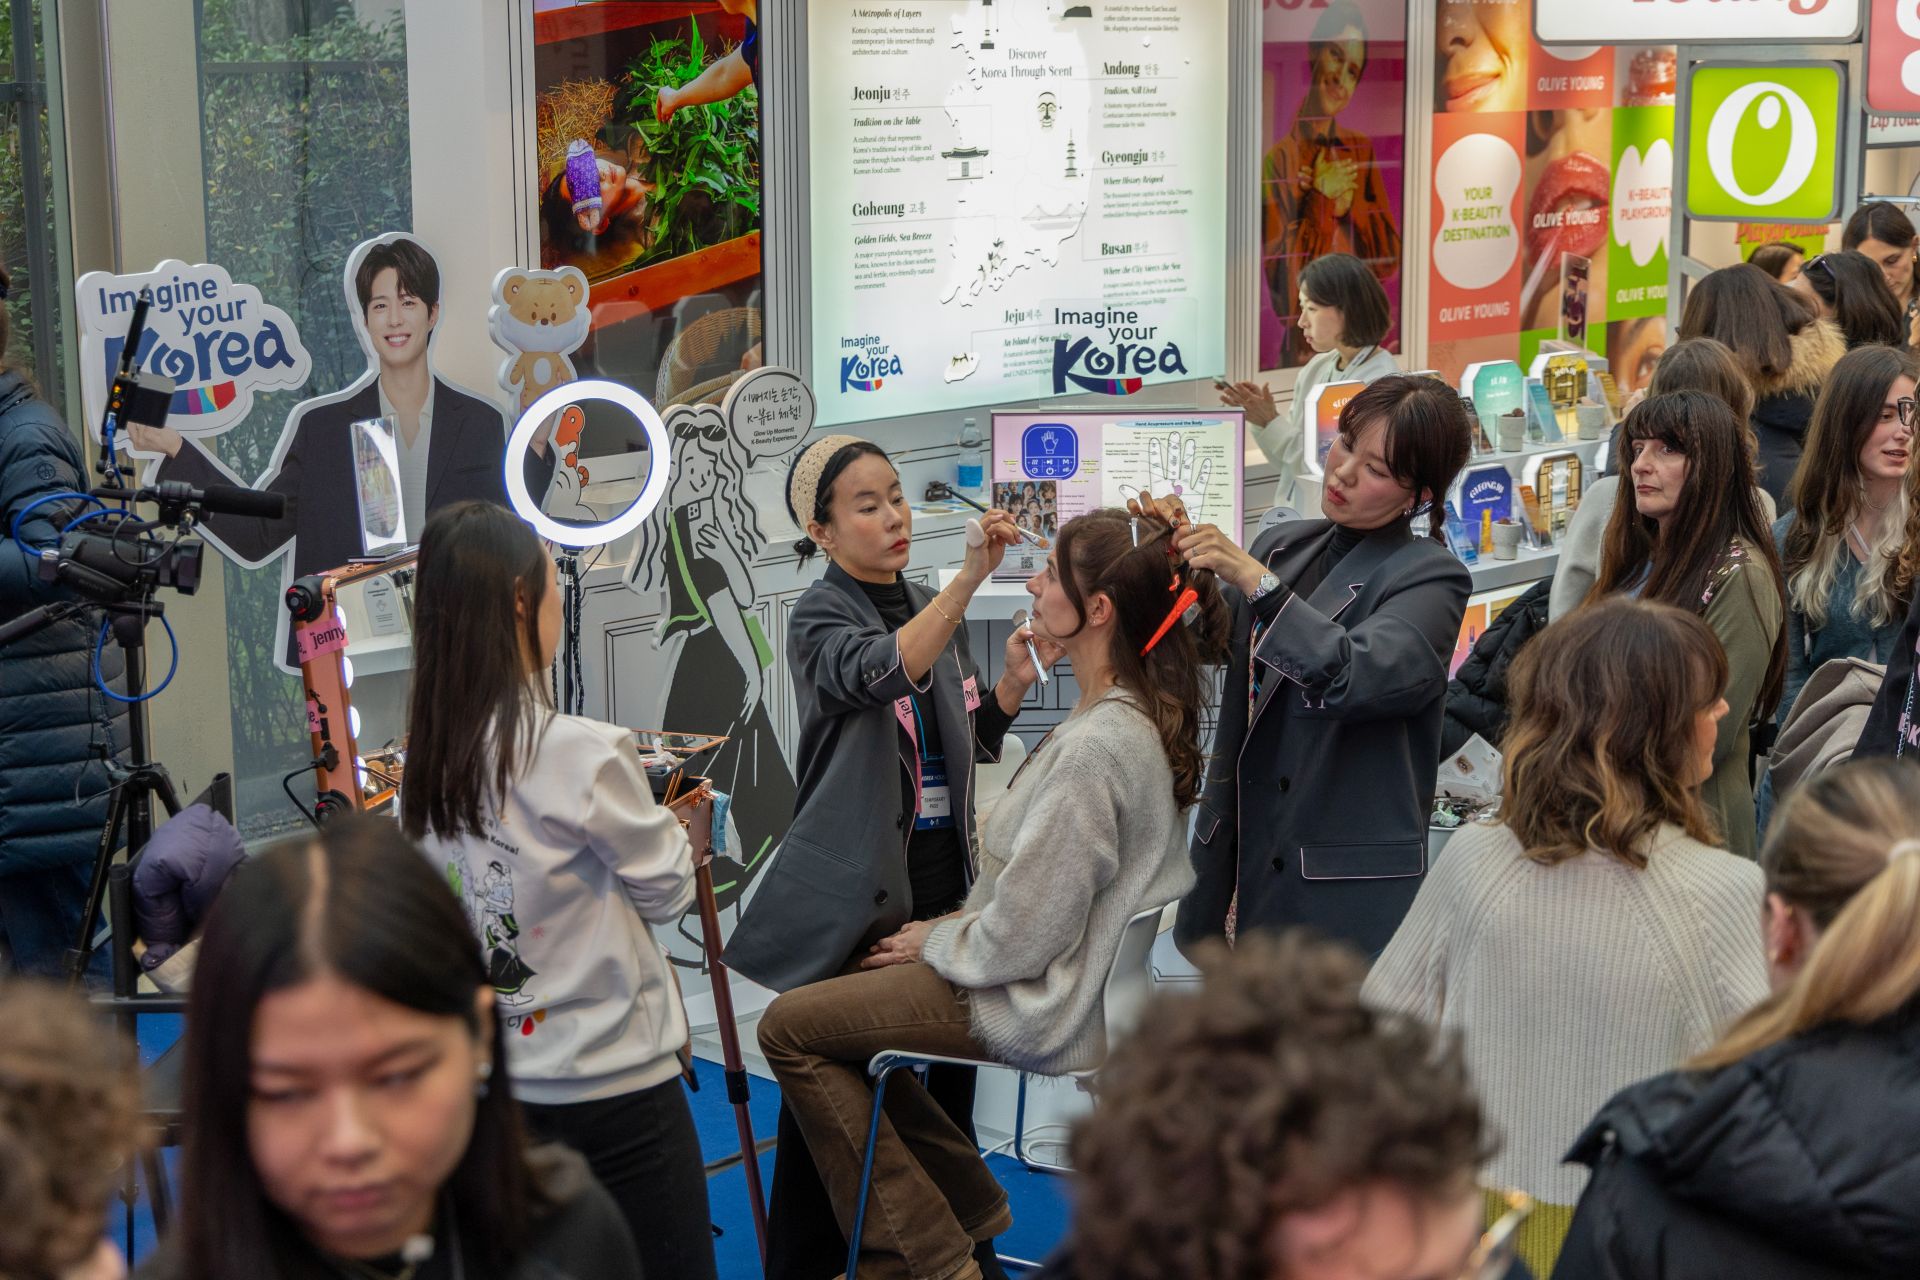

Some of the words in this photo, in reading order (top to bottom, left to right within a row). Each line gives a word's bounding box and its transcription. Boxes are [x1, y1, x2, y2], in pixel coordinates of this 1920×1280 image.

[851, 9, 857, 17] A
[859, 9, 892, 20] Metropolis
[894, 8, 902, 20] of
[902, 9, 922, 20] Layers
[1008, 48, 1047, 60] Discover
[981, 66, 1007, 78] Korea
[1010, 64, 1046, 80] Through
[1048, 65, 1072, 77] Scent
[1102, 60, 1140, 78] Andong
[1537, 76, 1569, 92] OLIVE
[1570, 75, 1605, 91] YOUNG
[850, 85, 891, 104] Jeonju
[892, 88, 911, 100] 전주
[854, 118, 882, 127] Tradition
[893, 117, 903, 126] the
[905, 116, 921, 125] Table
[1102, 148, 1149, 166] Gyeongju
[1464, 186, 1493, 200] YOUR
[852, 200, 905, 218] Goheung
[1452, 205, 1503, 222] K-BEAUTY
[1532, 212, 1564, 228] OLIVE
[1565, 208, 1600, 226] YOUNG
[854, 235, 876, 245] Golden
[878, 233, 898, 243] Fields,
[899, 233, 911, 242] Sea
[912, 232, 932, 240] Breeze
[1443, 224, 1511, 242] DESTINATION
[1101, 242, 1132, 256] Busan
[99, 275, 218, 315] Imagine
[1616, 286, 1645, 303] OLIVE
[178, 299, 247, 337] your
[1004, 308, 1025, 326] Jeju
[1054, 307, 1139, 329] Imagine
[1440, 305, 1471, 323] OLIVE
[1474, 301, 1510, 320] YOUNG
[841, 334, 881, 349] Imagine
[1108, 324, 1158, 345] your
[866, 344, 890, 360] your
[840, 354, 904, 394] Korea
[1052, 335, 1189, 396] Korea
[747, 408, 776, 426] K-뷰티
[778, 404, 802, 421] 체험!
[772, 435, 797, 443] Experience
[490, 836, 519, 855] Korea!
[506, 1016, 522, 1029] CJ
